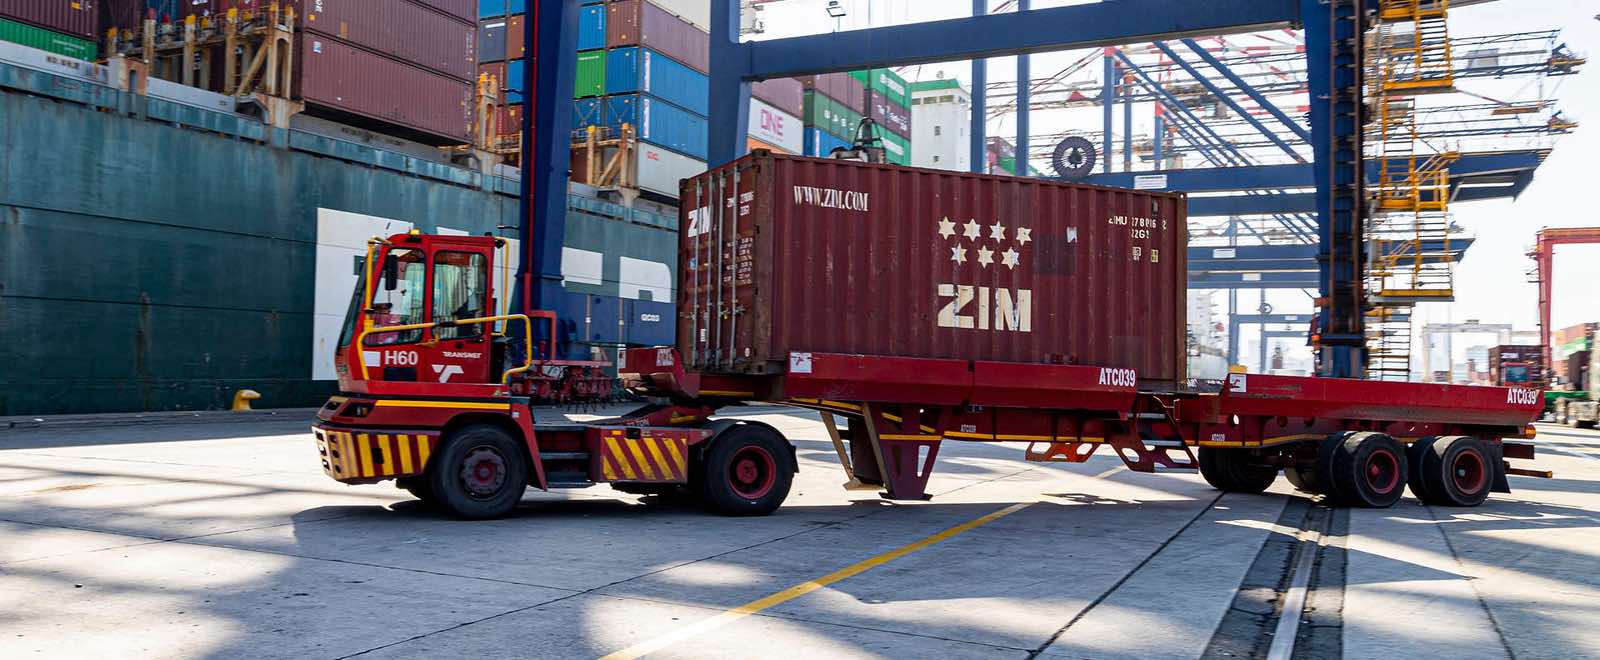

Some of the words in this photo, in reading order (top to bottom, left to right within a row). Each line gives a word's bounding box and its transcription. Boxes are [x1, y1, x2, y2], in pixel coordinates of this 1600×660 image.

[761, 109, 784, 137] ONE
[938, 284, 1032, 332] ZIM
[385, 350, 418, 365] H60
[443, 351, 482, 359] TRANSNET
[1099, 367, 1137, 388] ATC039
[1507, 388, 1538, 405] ATC039
